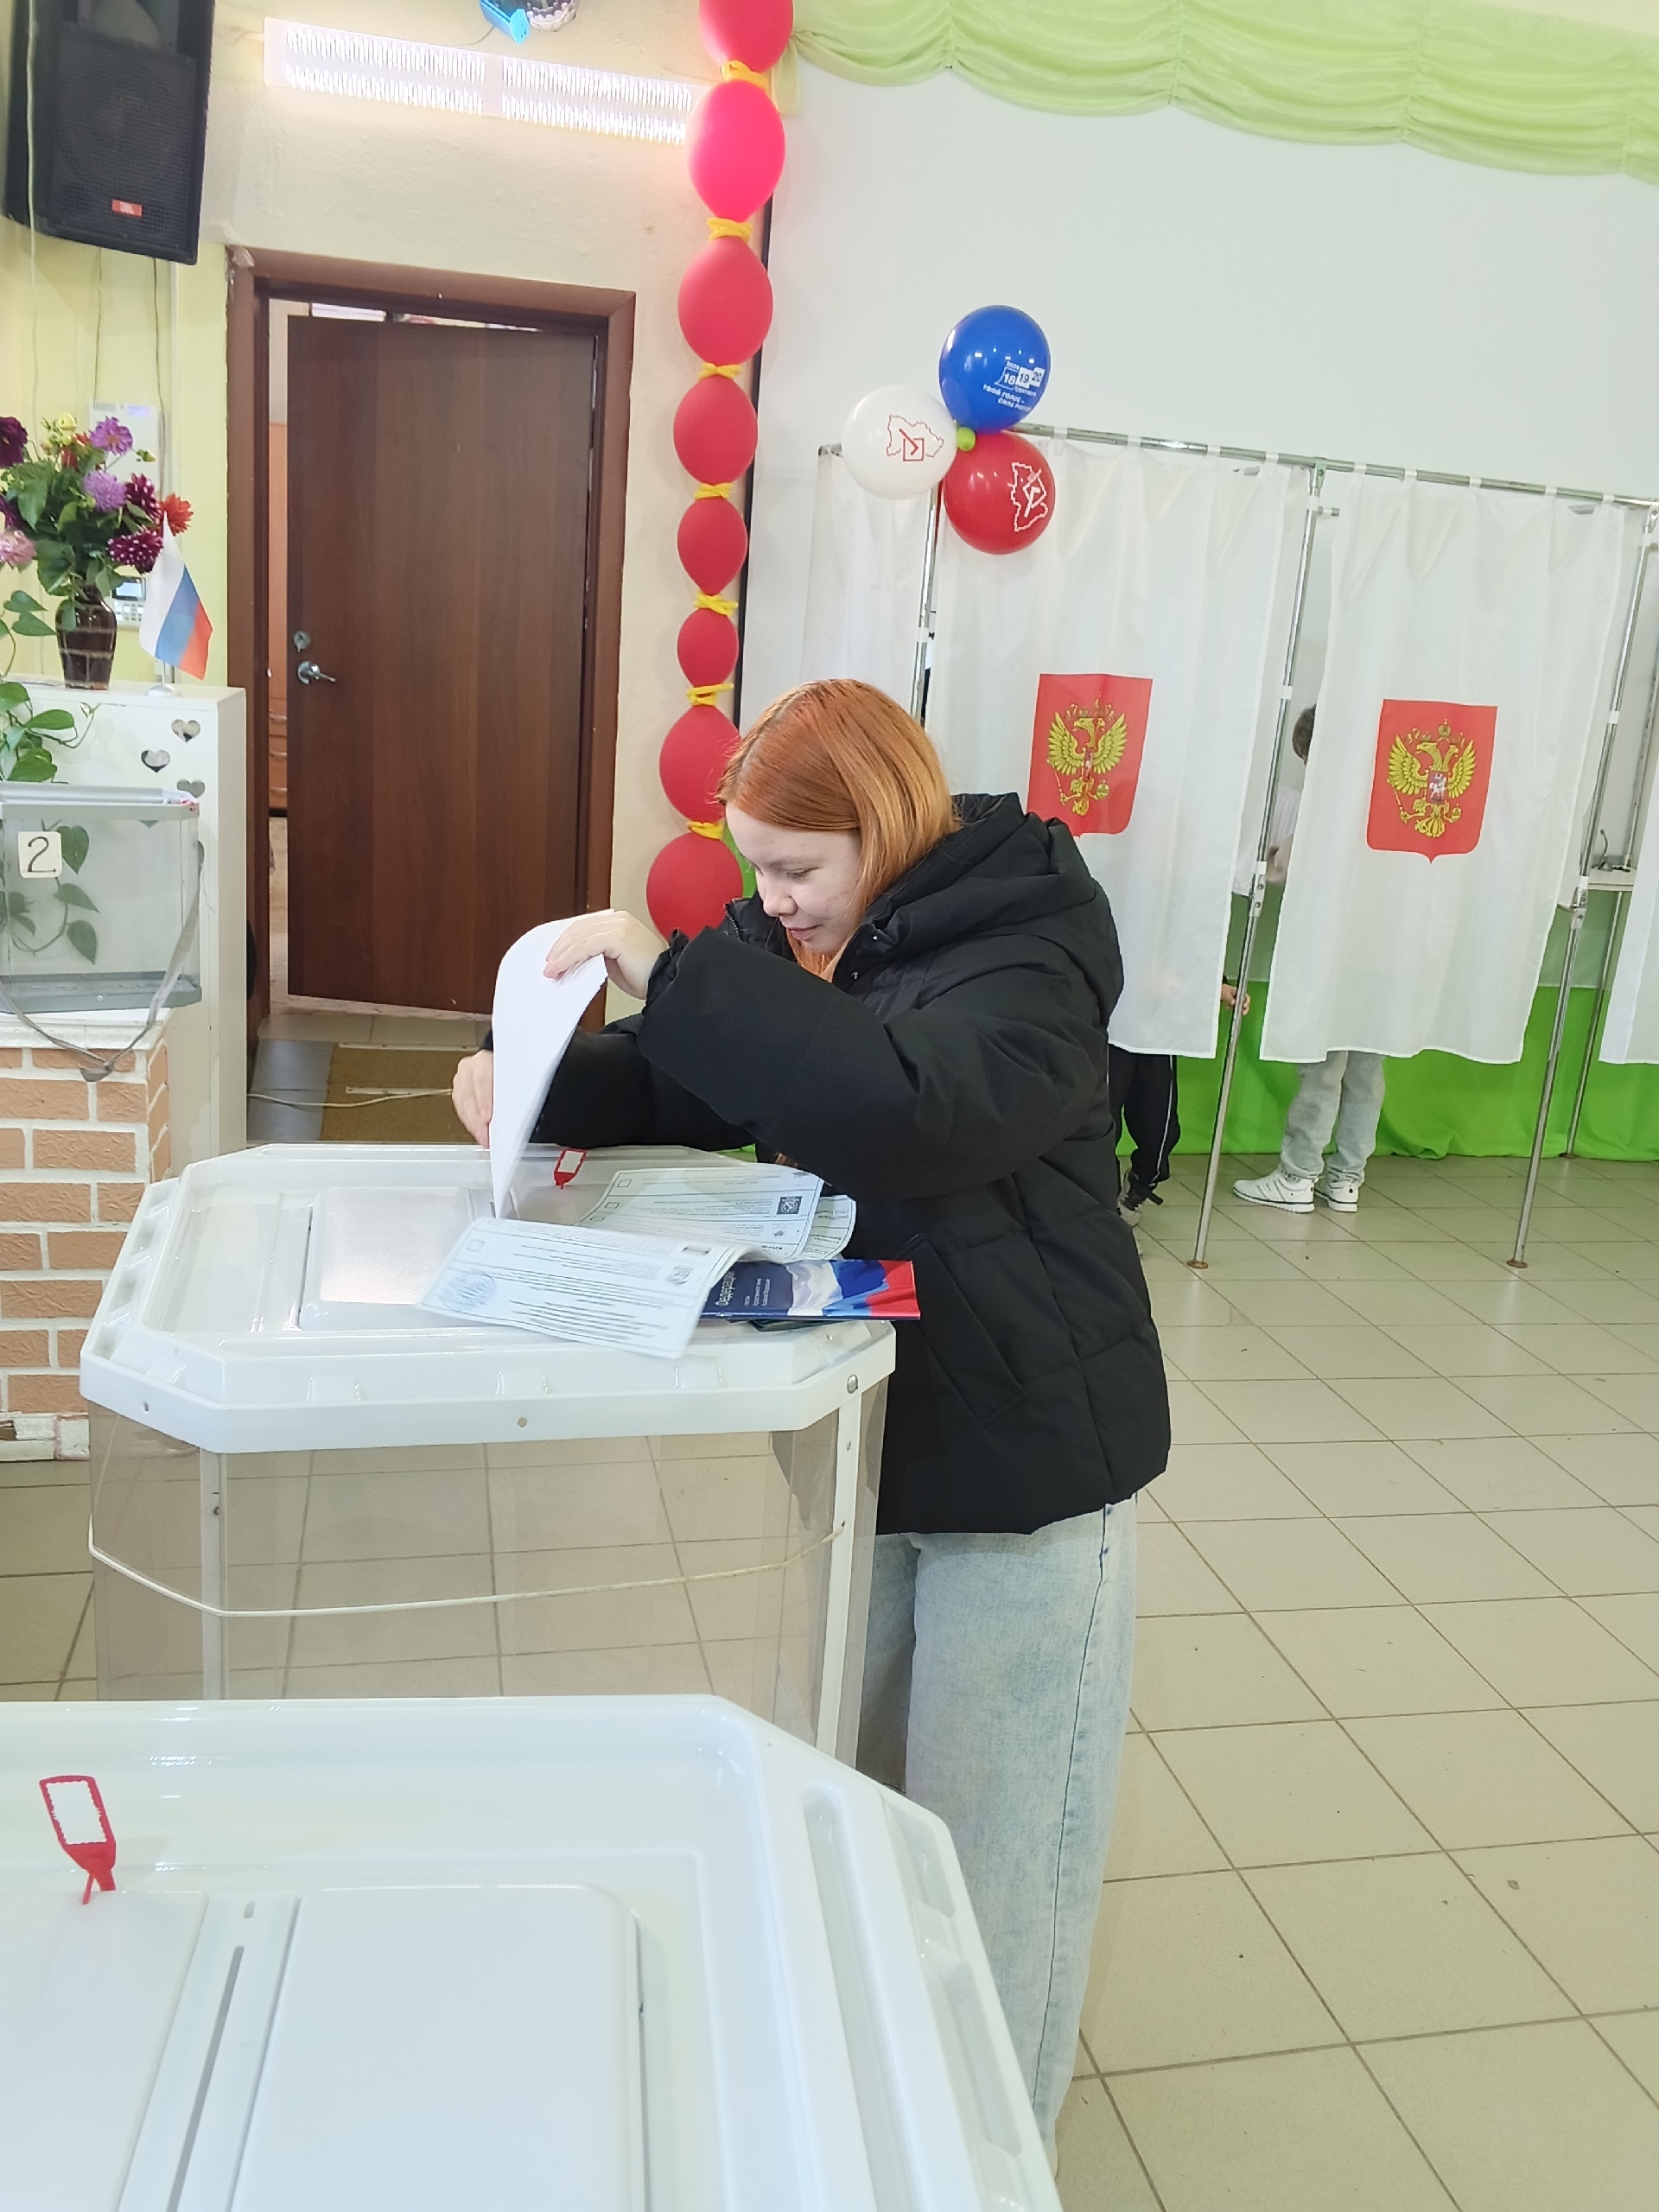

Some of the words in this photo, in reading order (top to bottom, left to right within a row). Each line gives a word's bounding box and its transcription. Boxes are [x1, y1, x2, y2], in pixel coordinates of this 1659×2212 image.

[1004, 372, 1016, 385] 18
[1020, 373, 1030, 384] 19
[1032, 372, 1042, 383] 20
[28, 836, 57, 873] 2
